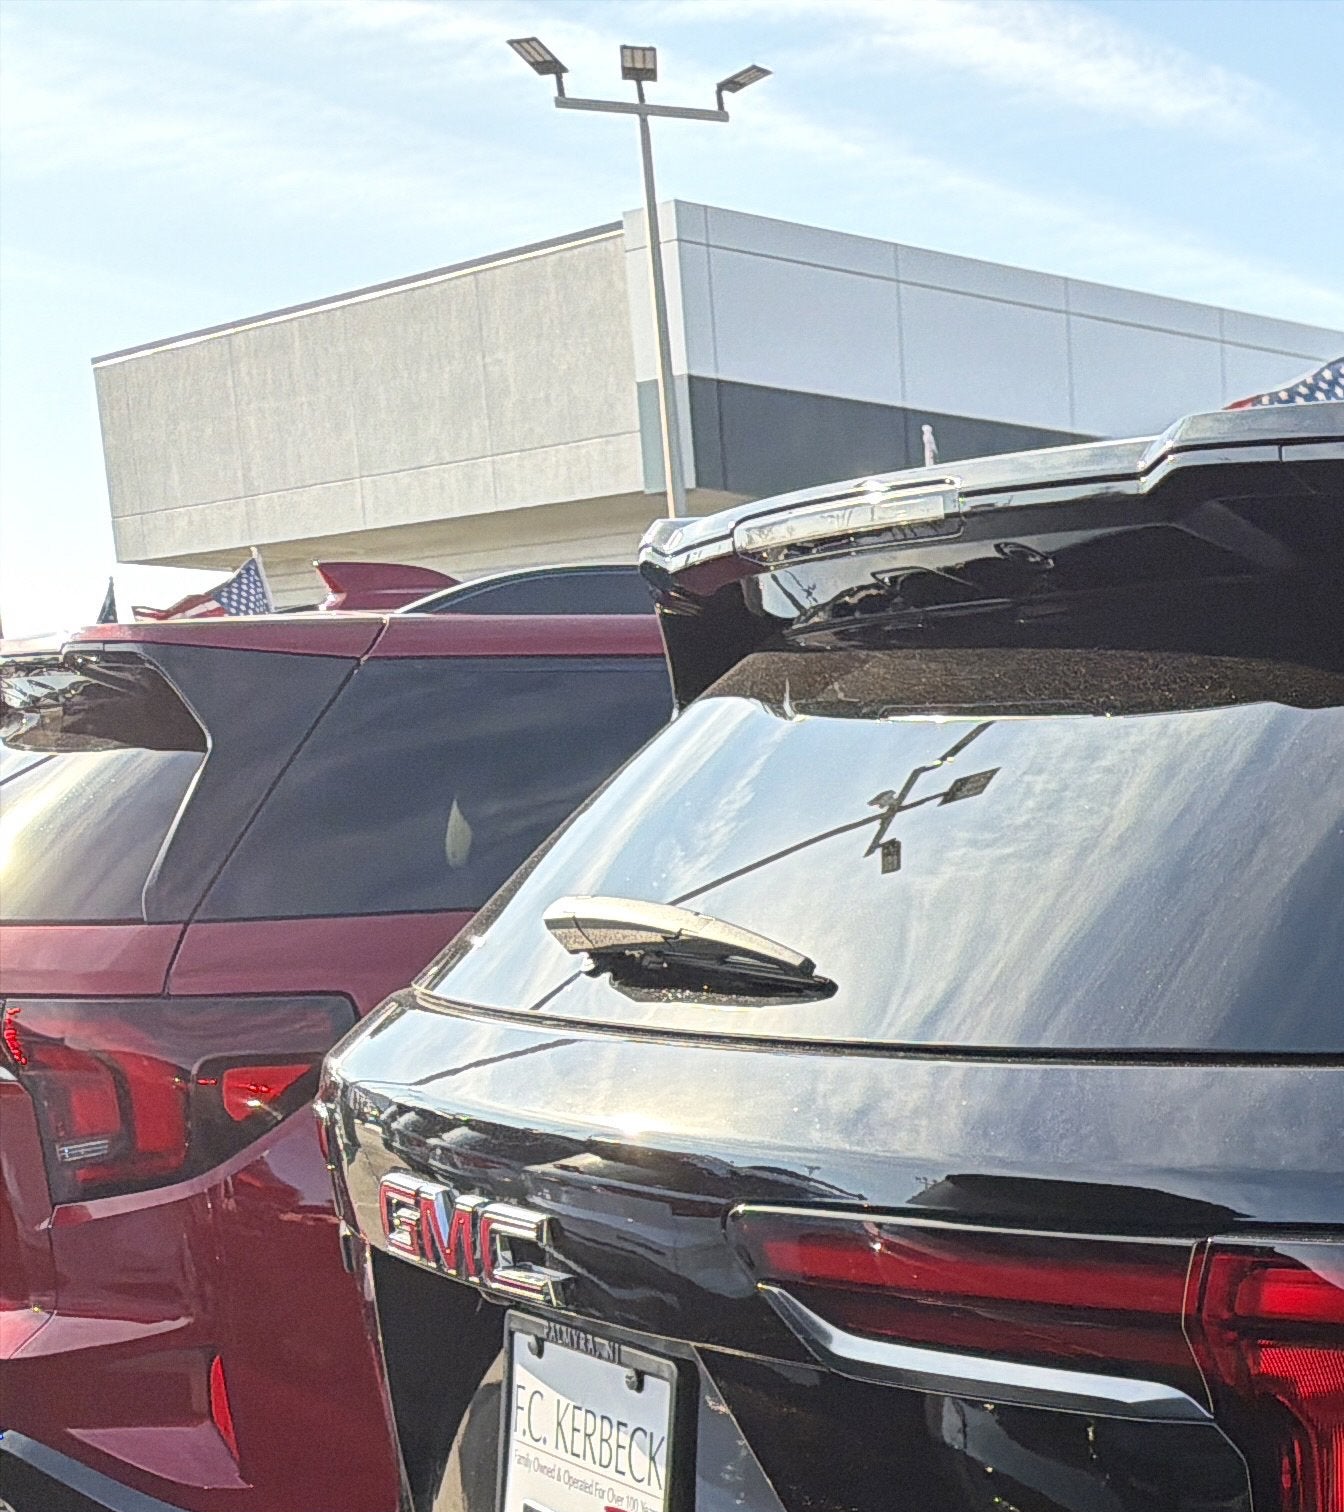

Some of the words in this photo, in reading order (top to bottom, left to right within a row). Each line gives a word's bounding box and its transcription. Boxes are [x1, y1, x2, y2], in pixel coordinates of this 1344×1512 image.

[379, 1171, 572, 1308] GMC
[514, 1384, 546, 1445] F.C.
[555, 1399, 665, 1490] KERBECK
[514, 1448, 532, 1473] Family
[533, 1456, 556, 1480] Owned
[563, 1469, 593, 1496] Operated
[594, 1482, 606, 1499] For
[607, 1487, 624, 1507] Over
[626, 1495, 639, 1512] 100
